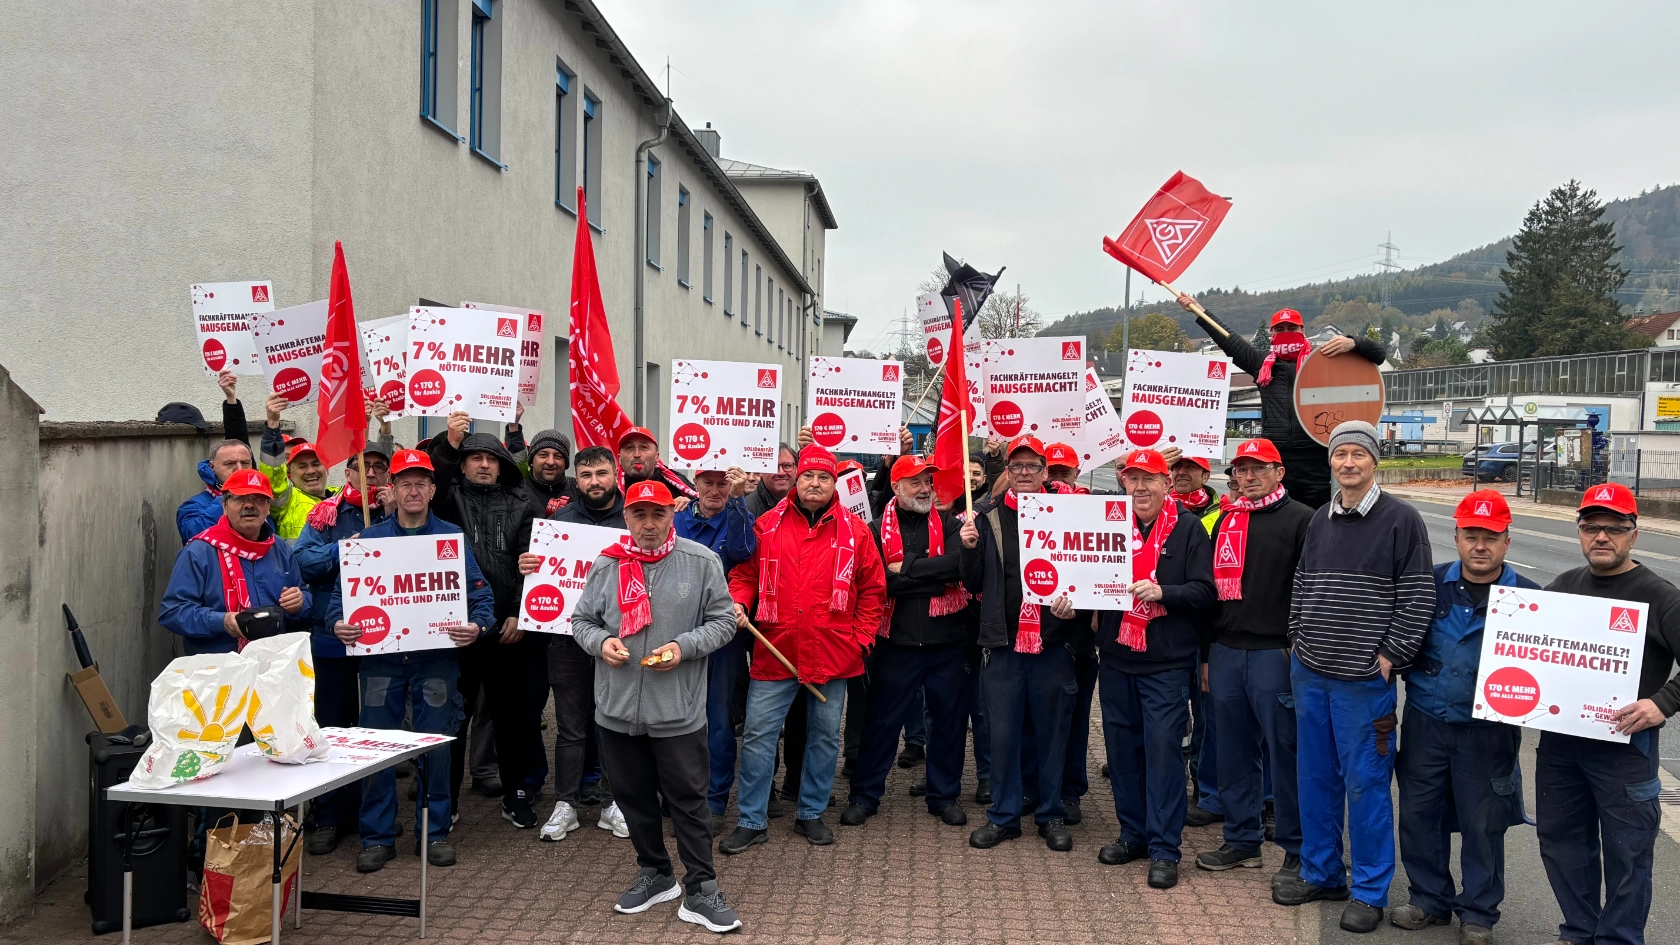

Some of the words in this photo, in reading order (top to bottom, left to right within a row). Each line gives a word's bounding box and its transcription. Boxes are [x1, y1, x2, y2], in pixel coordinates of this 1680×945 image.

[924, 322, 953, 334] HAUSGEM
[265, 334, 326, 353] FACHKRÄFTEMA
[521, 340, 539, 357] HR
[268, 343, 324, 364] HAUSGEM
[452, 343, 515, 367] MEHR
[397, 370, 406, 379] NÖ
[439, 362, 466, 372] NÖTIG
[469, 365, 488, 375] UND
[490, 368, 513, 377] FAIR!
[990, 372, 1078, 382] FACHKRÄFTEMANGEL?!
[388, 389, 398, 399] 170
[816, 388, 896, 398] FACHKRÄFTEMANGEL?!
[990, 381, 1078, 394] HAUSGEMACHT!
[1133, 384, 1221, 398] FACHKRÄFTEMANGEL?!
[716, 397, 776, 417] MEHR
[816, 396, 895, 410] HAUSGEMACHT!
[1132, 393, 1220, 410] HAUSGEMACHT!
[1085, 405, 1107, 422] CHT!
[703, 416, 730, 426] NÖTIG
[732, 419, 750, 427] UND
[752, 420, 774, 428] FAIR!
[1063, 532, 1126, 552] MEHR
[1050, 551, 1078, 562] NÖTIG
[1080, 554, 1099, 563] UND
[1102, 555, 1126, 563] FAIR!
[393, 571, 460, 594] MEHR
[380, 596, 410, 606] NÖTIG
[413, 595, 432, 604] UND
[436, 593, 460, 602] FAIR!
[360, 618, 376, 627] 170
[366, 626, 385, 634] Azubis
[1496, 630, 1630, 658] FACHKRÄFTEMANGEL?!
[1494, 642, 1628, 675] HAUSGEMACHT!
[1512, 685, 1536, 694] MEHR
